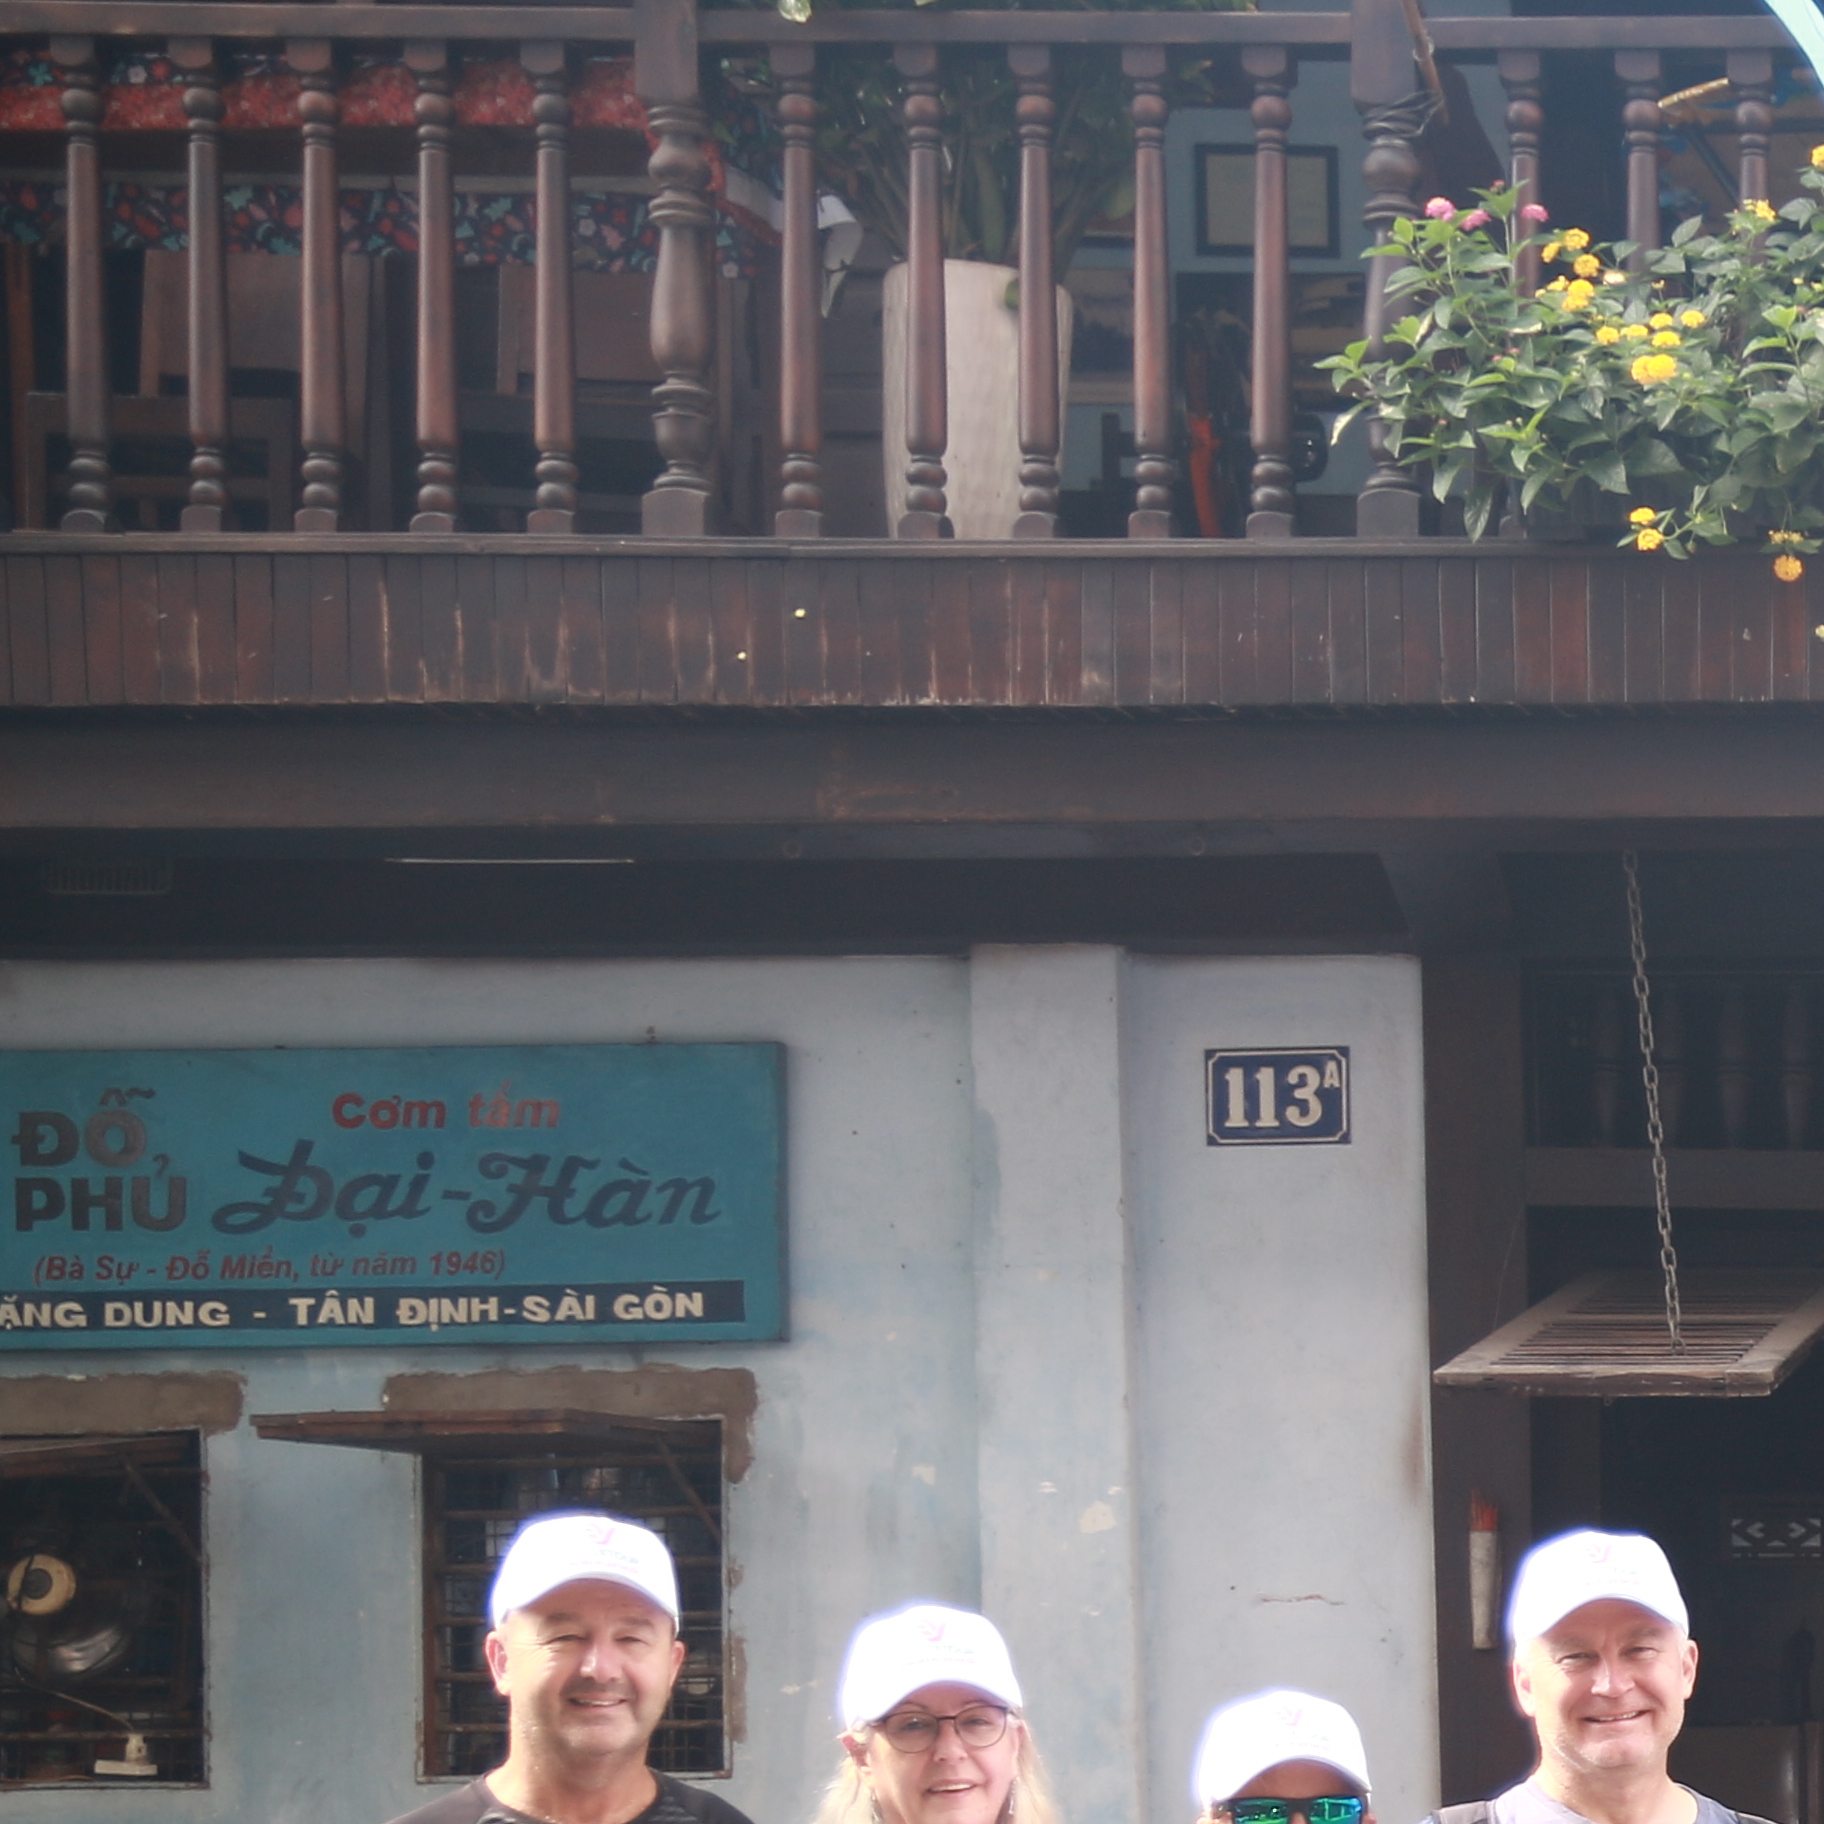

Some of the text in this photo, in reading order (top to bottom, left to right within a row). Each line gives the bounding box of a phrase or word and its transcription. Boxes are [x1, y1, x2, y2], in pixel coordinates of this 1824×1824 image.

[11, 1087, 156, 1169] ĐỖ
[331, 1080, 561, 1130] Cơm tấm
[15, 1153, 188, 1233] PHỦ
[34, 1254, 85, 1287] (Bà
[352, 1250, 416, 1277] năm
[429, 1250, 506, 1280] 1946)
[104, 1300, 231, 1328] DUNG
[288, 1289, 375, 1327] TÂN
[613, 1285, 704, 1321] GÒN
